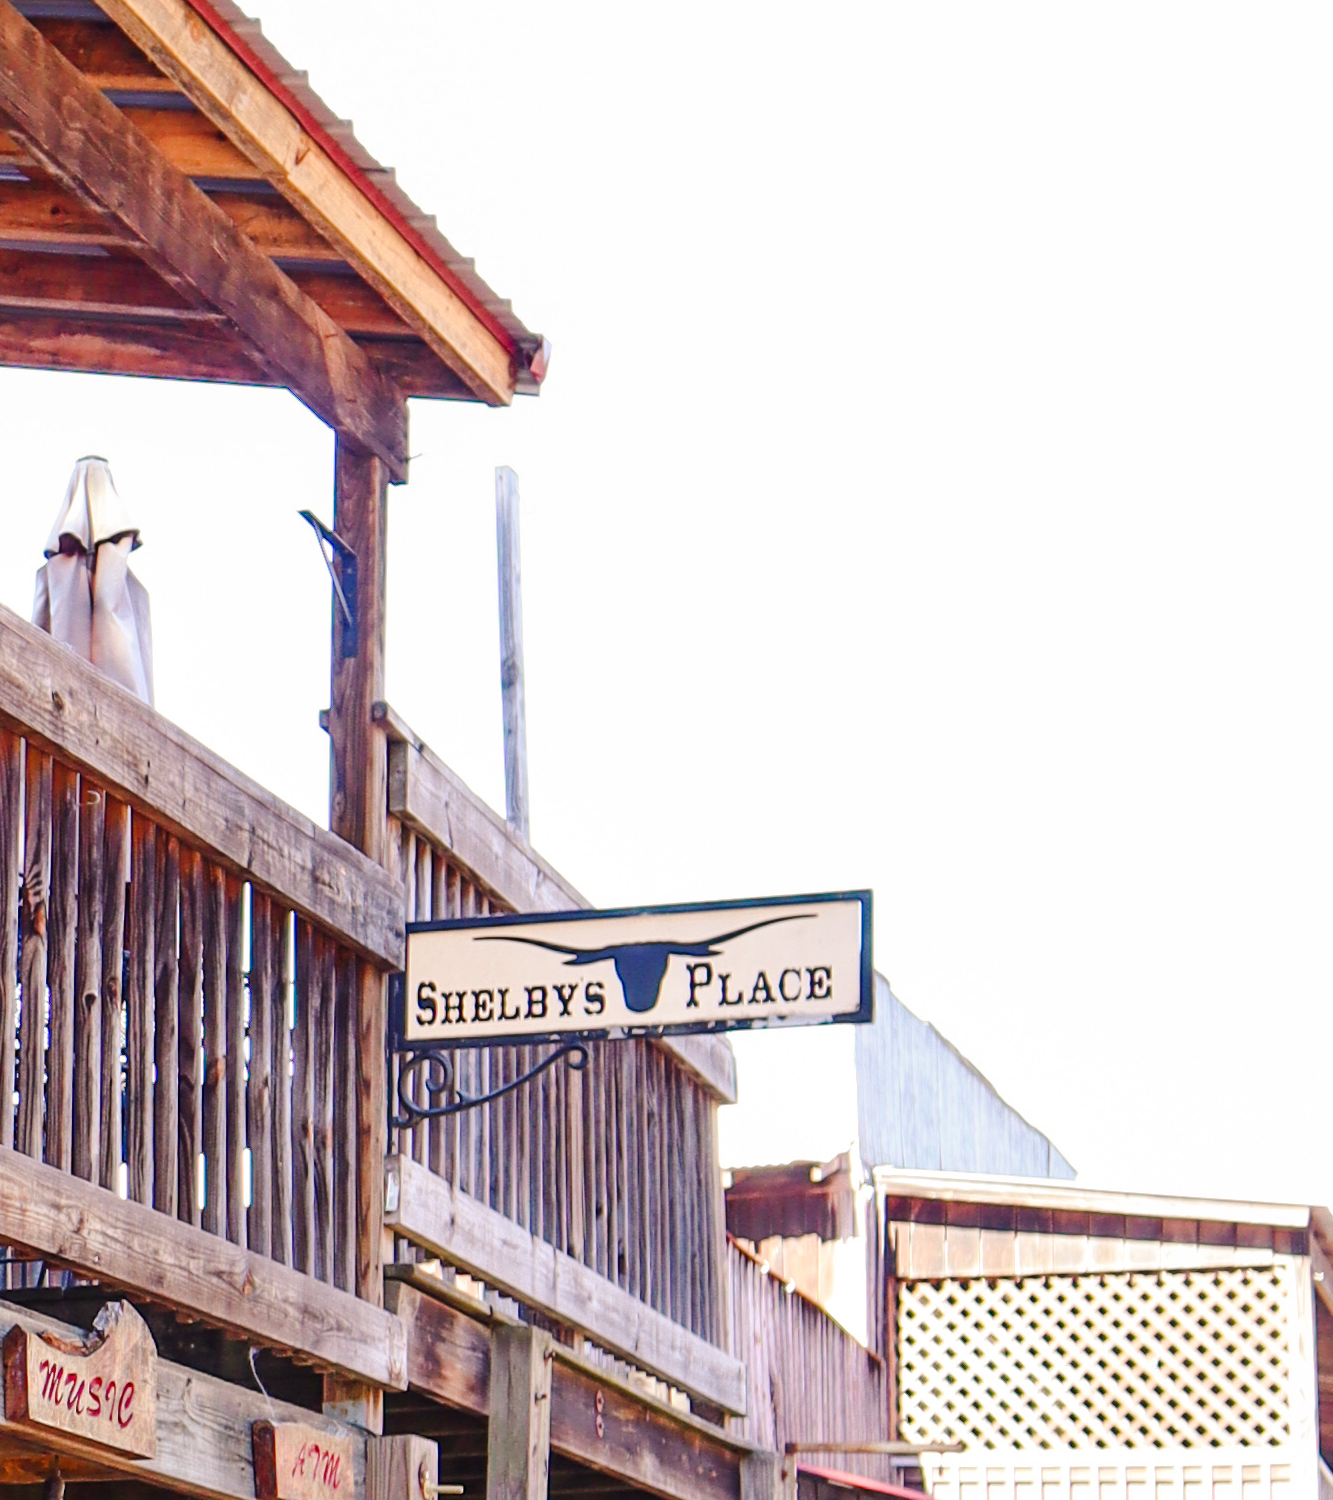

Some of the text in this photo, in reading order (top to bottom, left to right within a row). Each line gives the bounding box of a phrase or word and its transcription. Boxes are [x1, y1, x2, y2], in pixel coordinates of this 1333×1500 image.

[685, 961, 834, 1009] PLACE
[38, 1358, 136, 1429] MUSIC
[291, 1442, 342, 1491] ATM
